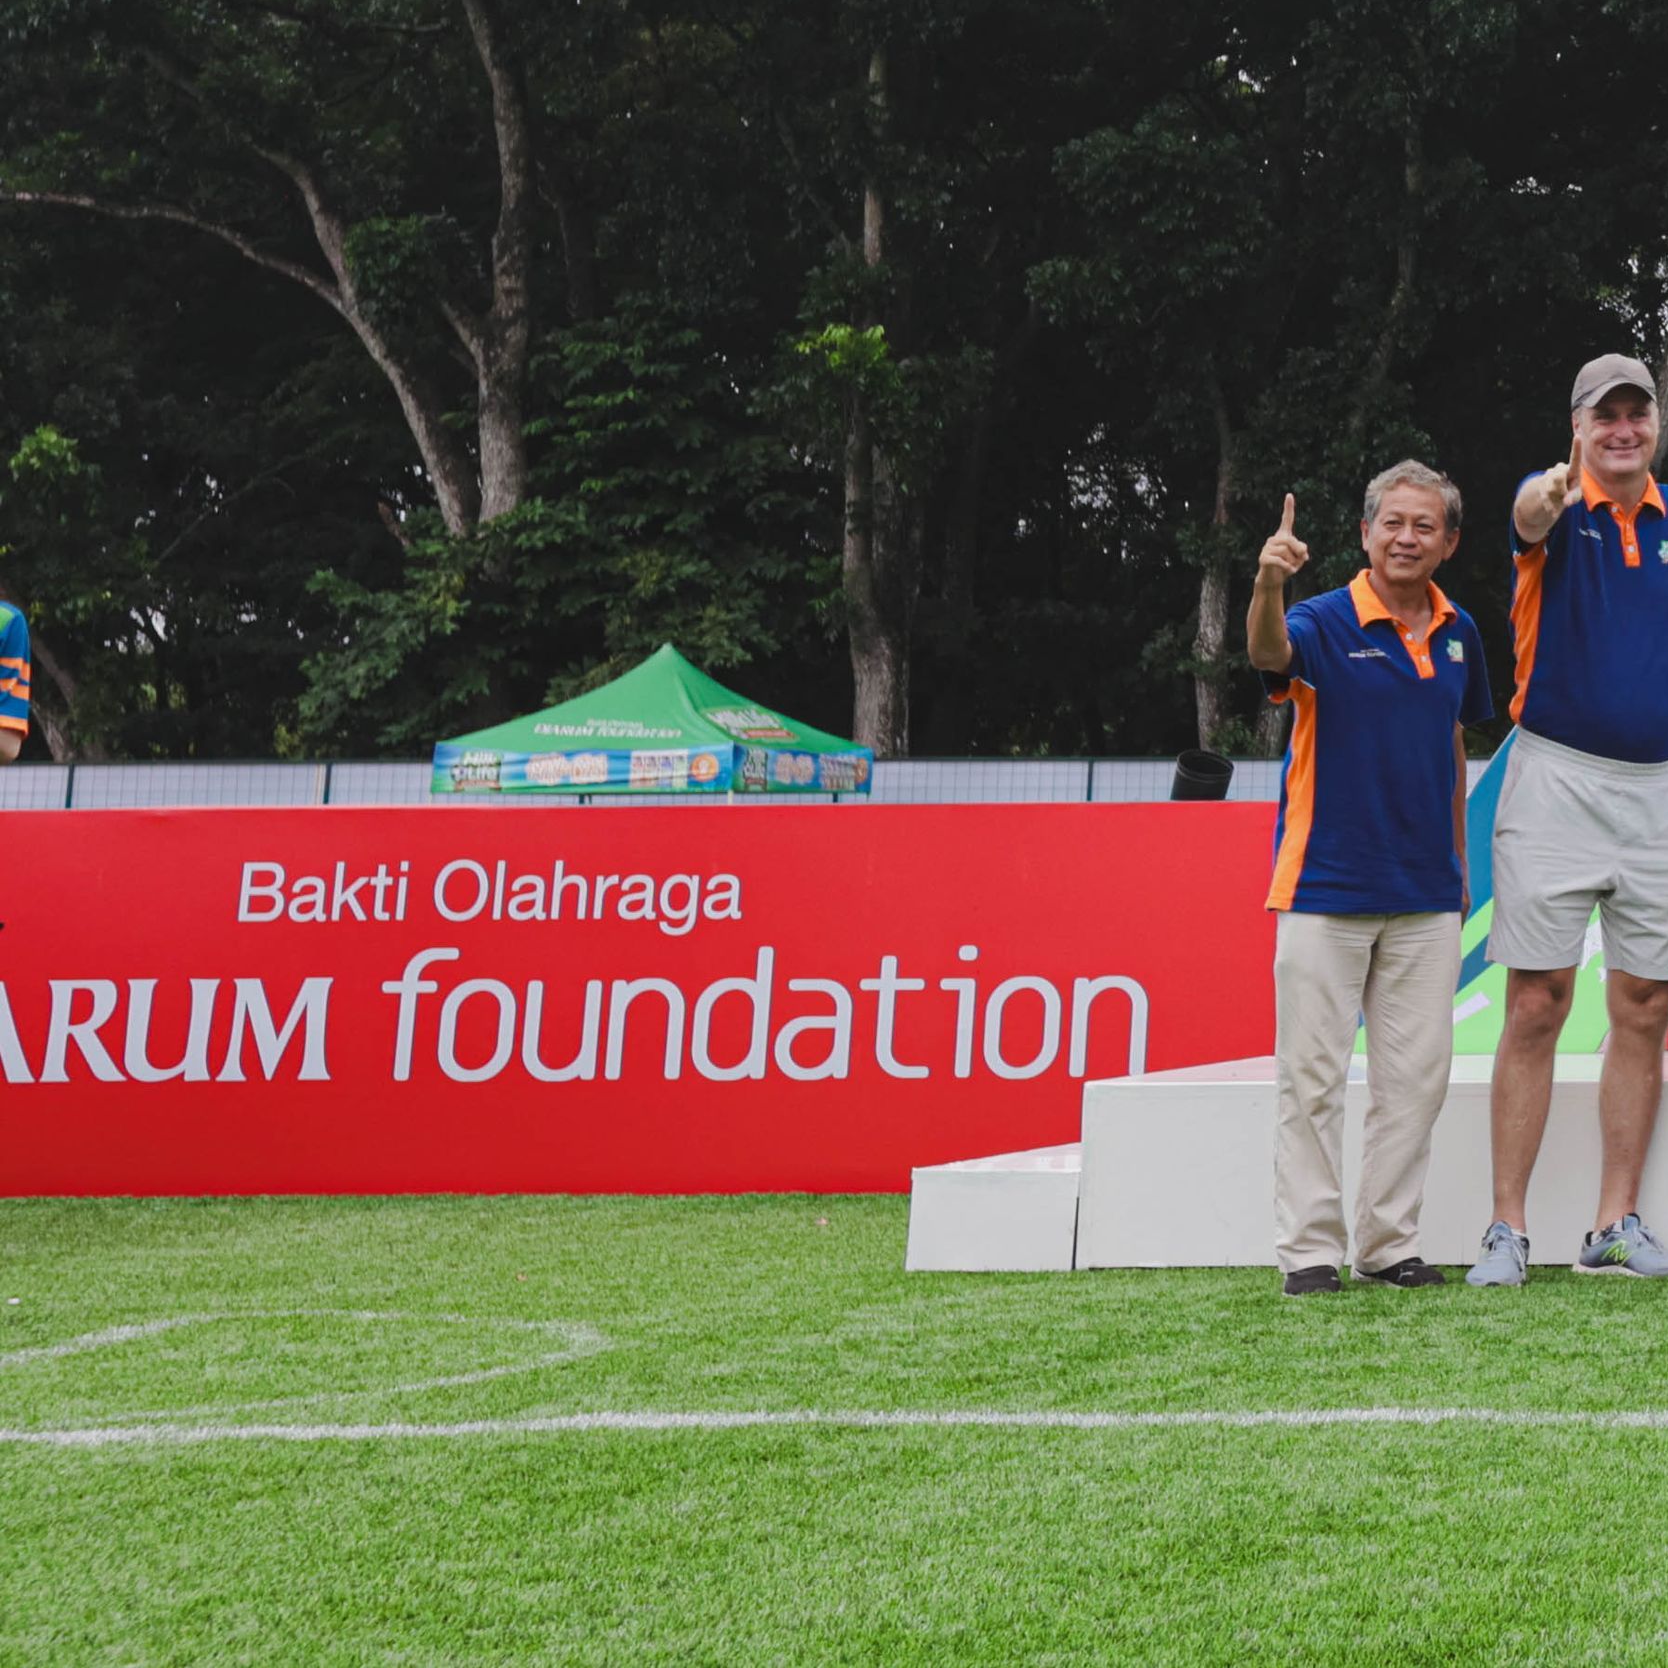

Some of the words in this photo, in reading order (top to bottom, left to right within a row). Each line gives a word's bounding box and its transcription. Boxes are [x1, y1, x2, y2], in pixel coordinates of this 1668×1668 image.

[237, 861, 410, 923] Bakti
[433, 859, 742, 936] Olahraga
[381, 944, 1149, 1083] foundation
